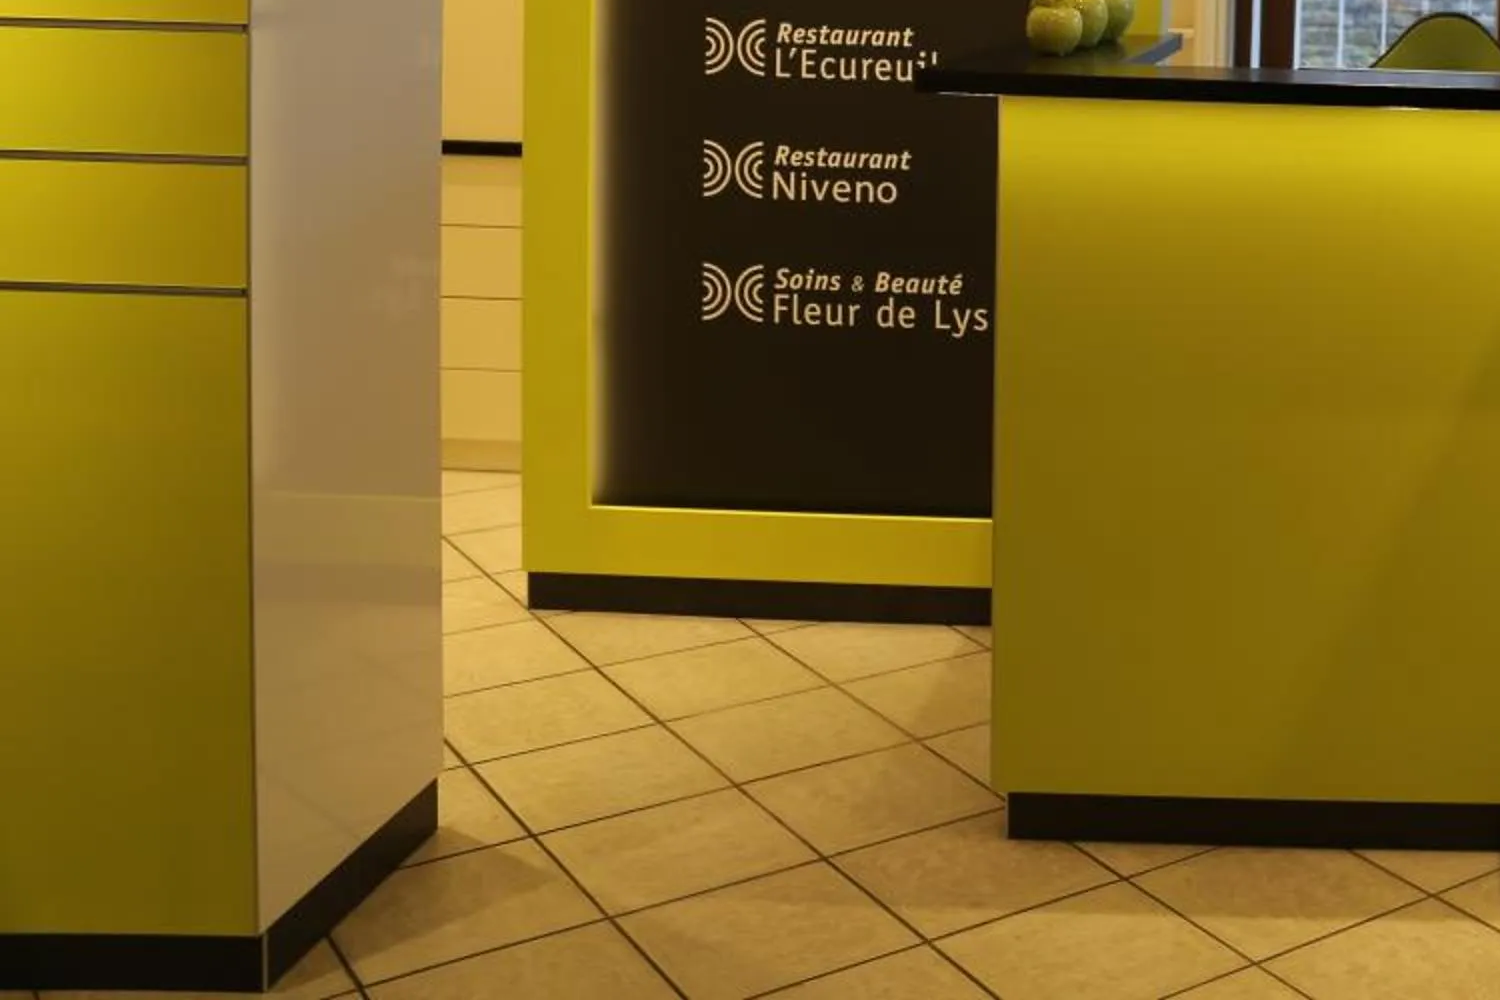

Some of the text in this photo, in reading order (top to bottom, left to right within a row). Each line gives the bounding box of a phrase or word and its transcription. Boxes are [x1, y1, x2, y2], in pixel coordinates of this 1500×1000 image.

[776, 22, 914, 47] Restaurant
[774, 145, 912, 171] Restaurant
[772, 172, 898, 203] Niveno
[774, 267, 963, 296] Soins & Beauté
[773, 293, 989, 338] Fleur de Lys
